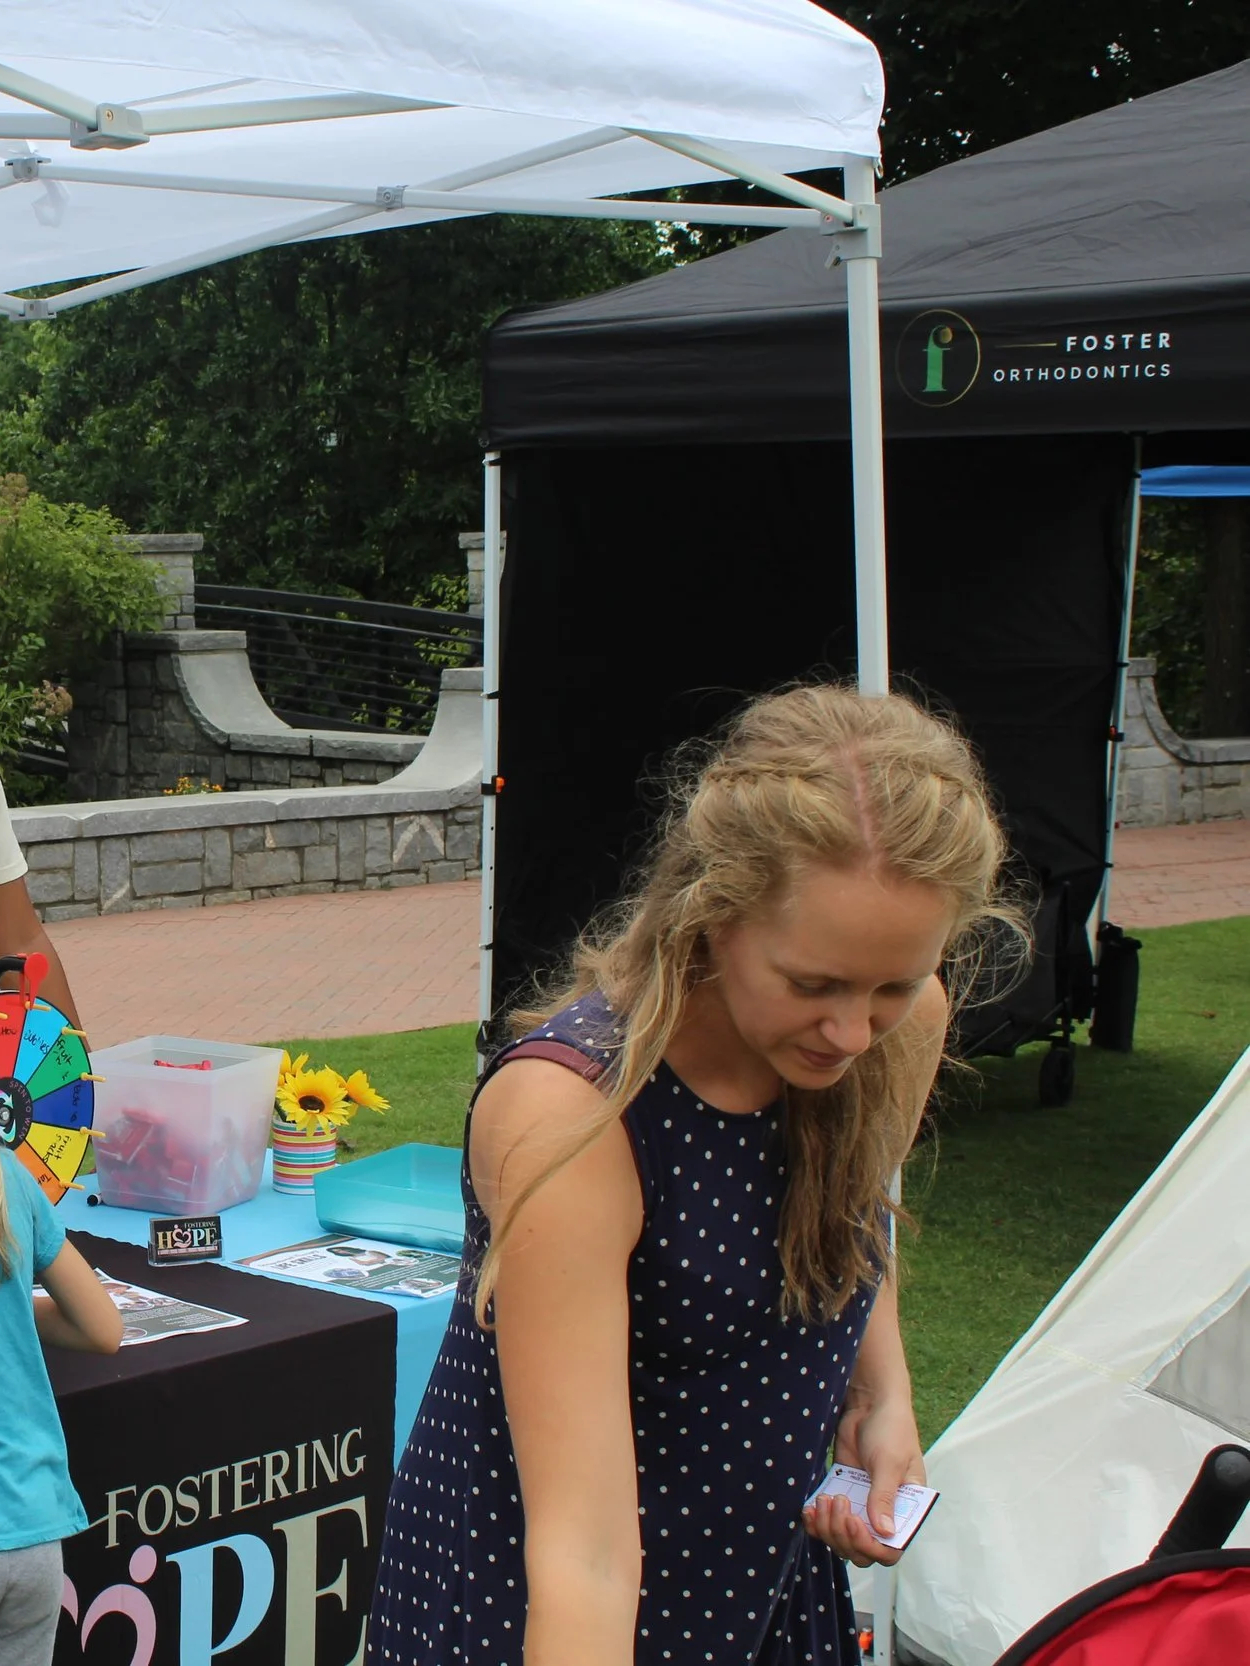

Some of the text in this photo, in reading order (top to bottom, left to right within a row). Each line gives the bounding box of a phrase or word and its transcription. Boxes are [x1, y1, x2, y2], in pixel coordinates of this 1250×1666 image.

[1066, 332, 1171, 352] FOSTER
[993, 363, 1171, 383] ORTHODONTICS
[157, 1225, 217, 1249] HOPE
[89, 1427, 367, 1549] FOSTERING
